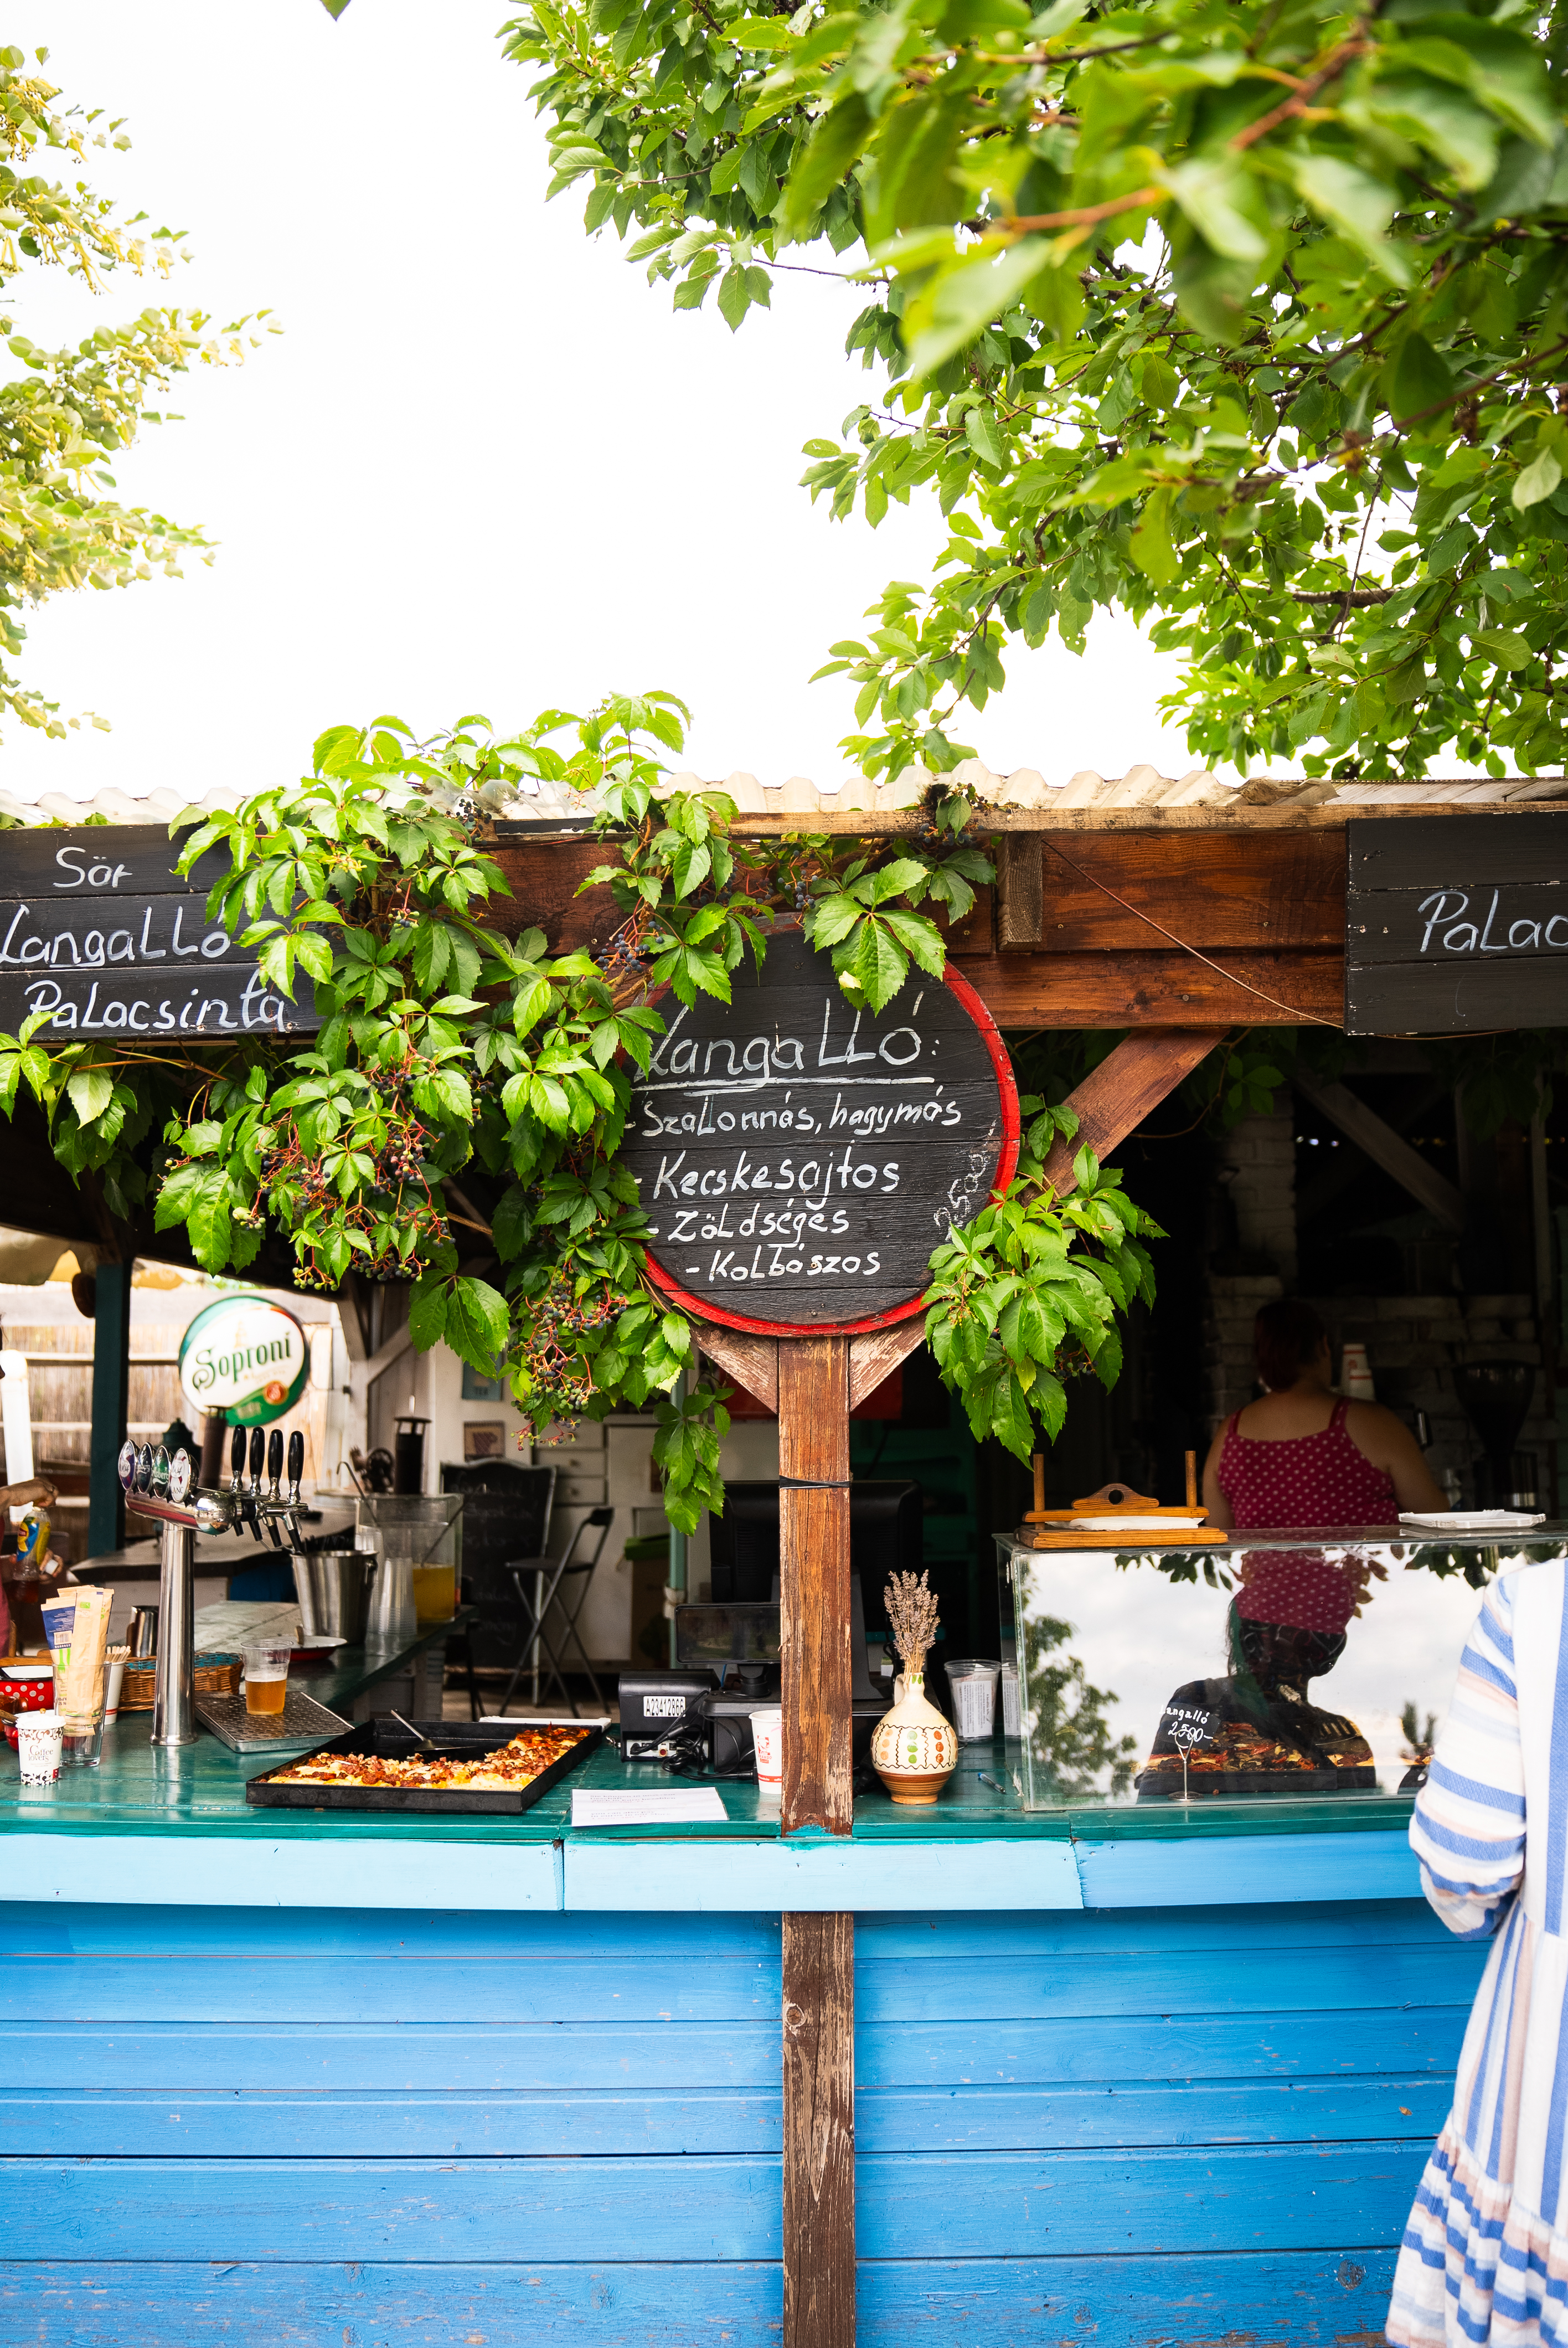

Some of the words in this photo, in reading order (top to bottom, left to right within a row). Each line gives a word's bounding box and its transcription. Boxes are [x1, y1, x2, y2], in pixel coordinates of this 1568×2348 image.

[53, 846, 133, 888] Sör
[828, 1085, 962, 1136] hagymás
[192, 1331, 291, 1394] Soproni
[646, 1698, 684, 1716] A23412866
[1158, 1704, 1210, 1724] Langalló
[28, 1754, 49, 1762] lovers
[30, 1745, 53, 1756] Coffee
